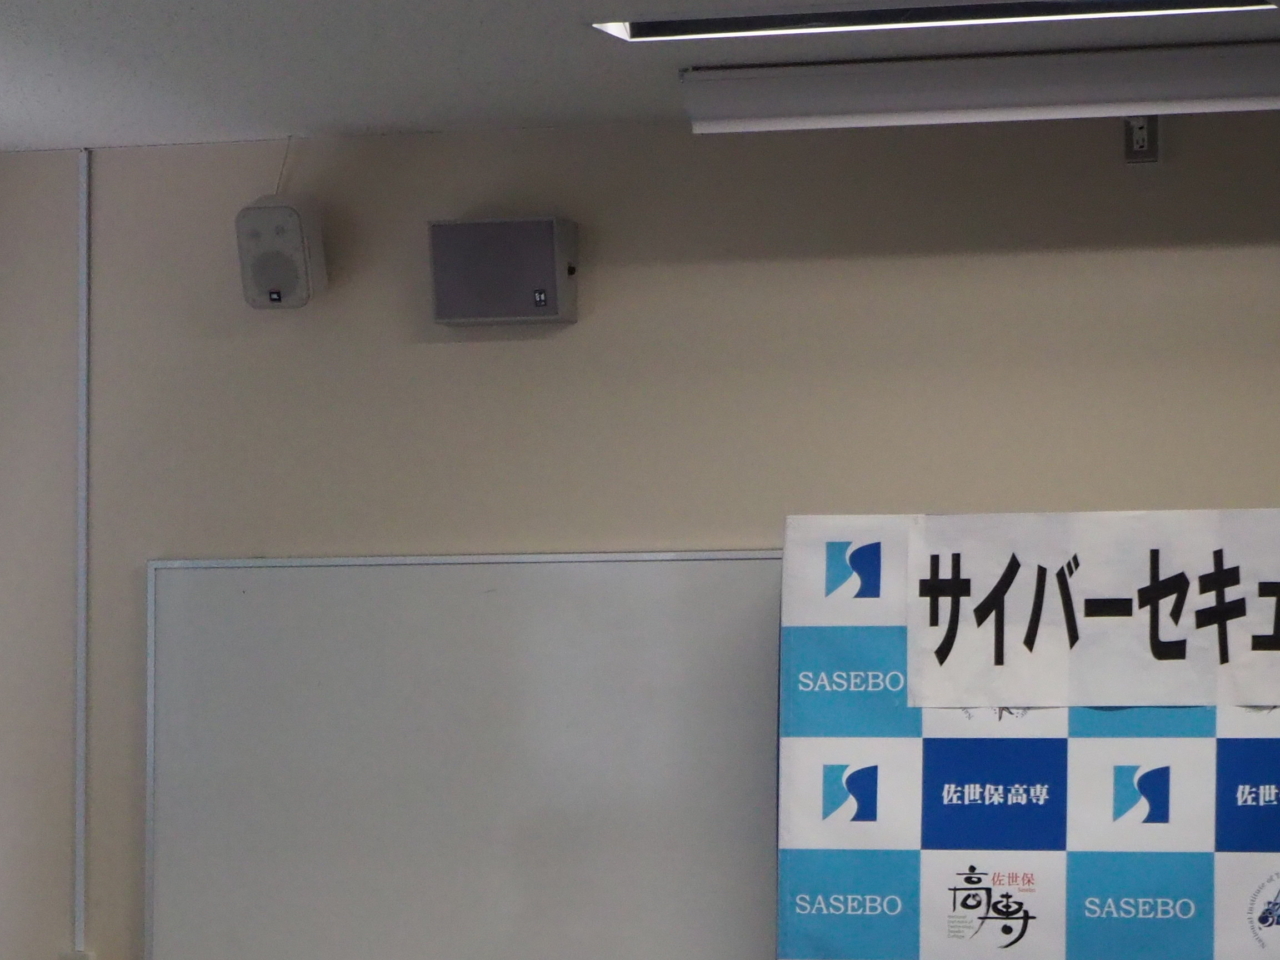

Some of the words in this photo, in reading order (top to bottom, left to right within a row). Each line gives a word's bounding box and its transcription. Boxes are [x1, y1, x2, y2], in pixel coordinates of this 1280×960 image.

[919, 548, 1280, 667] サイバーセキュ
[798, 671, 905, 692] SASEBO
[942, 784, 1049, 806] 佐世保高専
[1236, 784, 1280, 806] 佐世
[991, 872, 1035, 887] 佐世保
[795, 894, 902, 916] SASEBO
[1084, 897, 1196, 919] SASEBO
